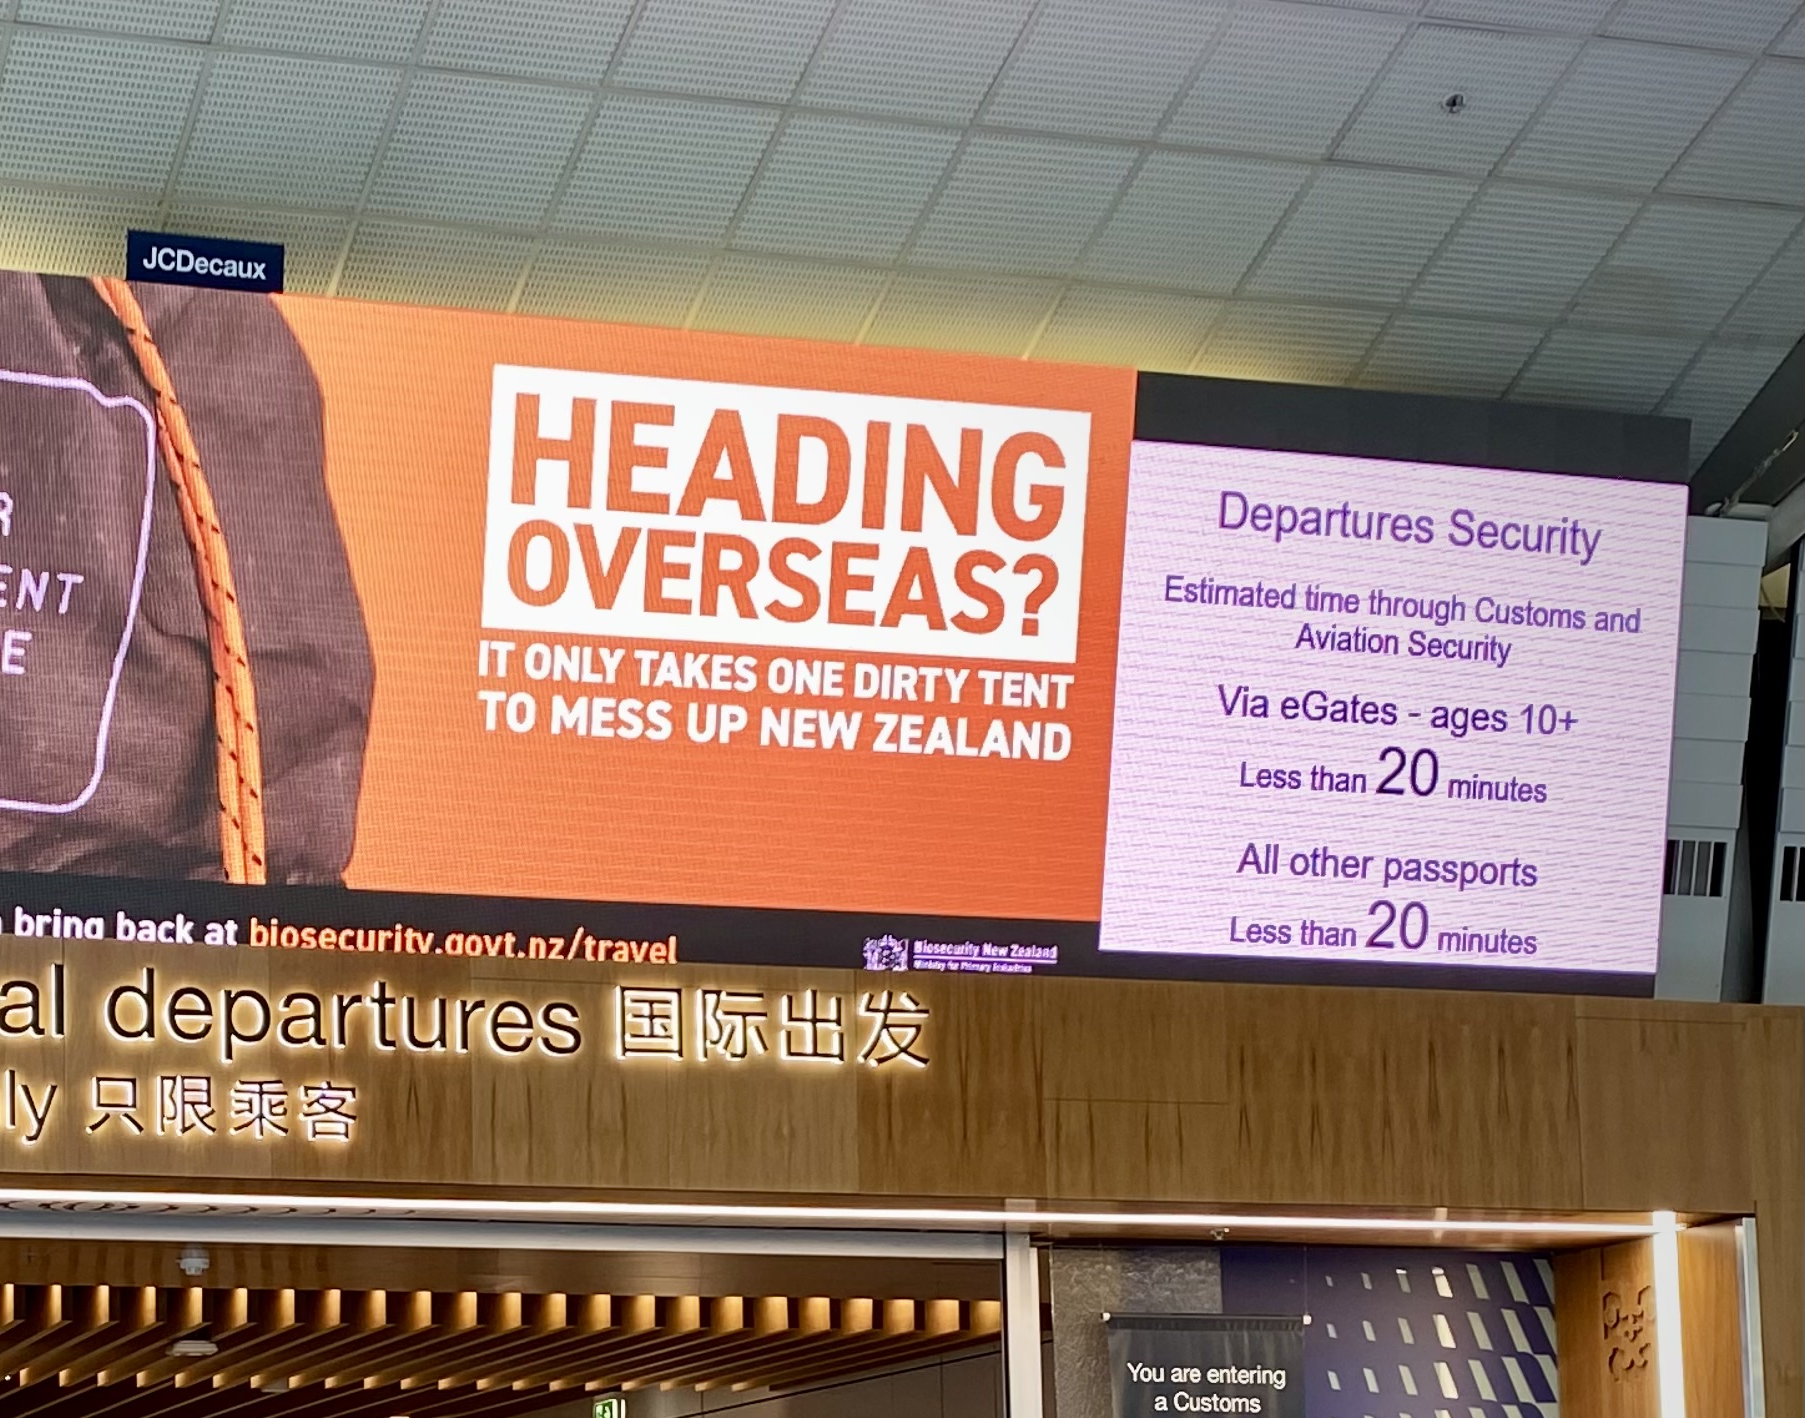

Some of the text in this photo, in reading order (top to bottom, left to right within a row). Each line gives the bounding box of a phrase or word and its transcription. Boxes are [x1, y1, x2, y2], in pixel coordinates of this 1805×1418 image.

[140, 245, 267, 281] JCDecaux
[508, 391, 1067, 542] HEADING
[1218, 488, 1603, 564] Departures Security
[506, 518, 1062, 637] OVERSEAS?
[1164, 572, 1642, 632] Estimated time through Customs and
[476, 637, 1075, 710] IT ONLY TAKES ONE DIRTY TENT
[1294, 622, 1512, 668] Aviation Security
[476, 689, 1072, 763] TO MESS UP NEW ZEALAND
[1216, 682, 1579, 736] Via eGates ages 10+
[1238, 744, 1548, 802] Less than 20 minutes
[1236, 840, 1539, 890] All other passports
[115, 910, 195, 944] back
[204, 918, 238, 946] at
[913, 939, 1057, 958] Biosecurity New Zealand
[106, 976, 584, 1063] departures
[611, 979, 934, 1070] 国际出发
[85, 1074, 360, 1143] 只限乘客
[1126, 1361, 1286, 1388] You are entering
[1154, 1390, 1261, 1412] a Customs
